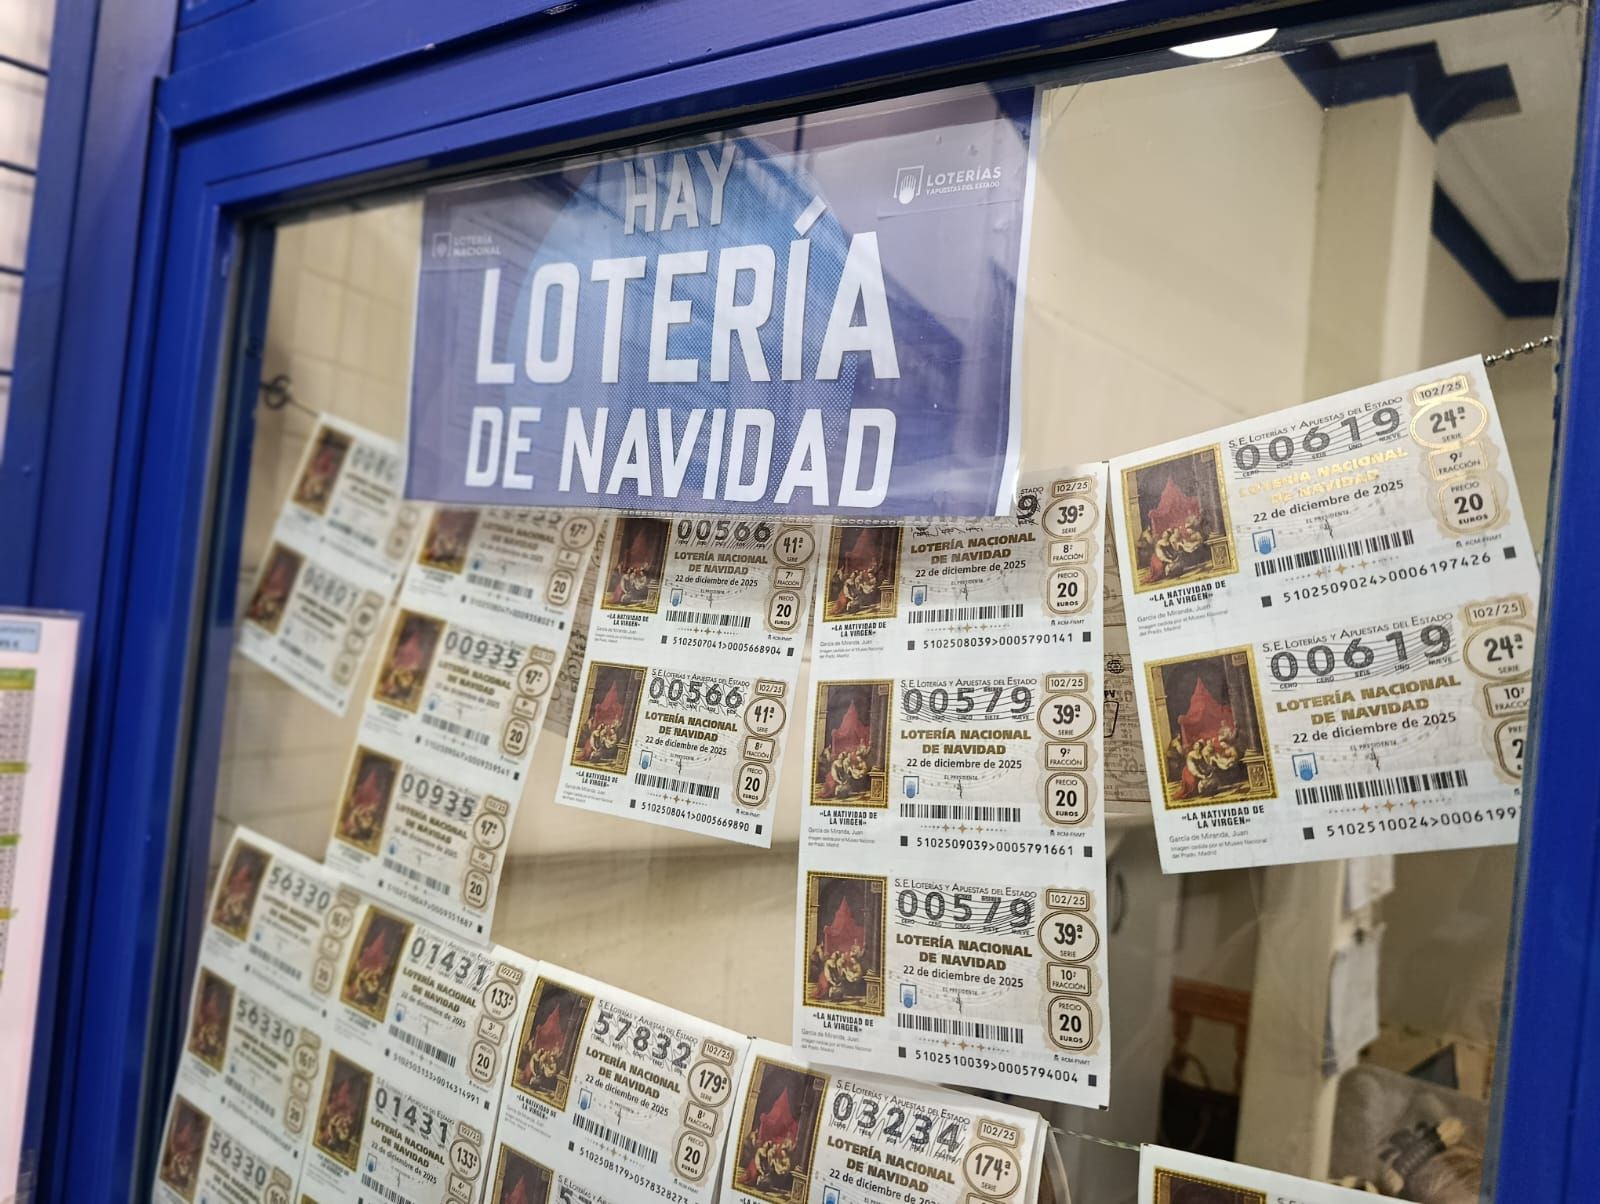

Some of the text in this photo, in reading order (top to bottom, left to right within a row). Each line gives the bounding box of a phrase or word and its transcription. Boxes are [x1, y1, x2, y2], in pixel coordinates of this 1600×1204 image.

[926, 164, 1001, 188] LOTERÍAS
[623, 142, 736, 235] HAY
[476, 195, 901, 384] LOTERÍA
[1419, 381, 1462, 399] 102/25
[1236, 407, 1402, 472] 00619
[465, 407, 897, 509] DE NAVIDAD
[1057, 481, 1087, 491] 102/25
[1253, 480, 1404, 523] 22 de diciembre de 2025
[1454, 492, 1485, 515] 20
[678, 518, 772, 542] 00566
[911, 538, 963, 553] LOTERÍA
[968, 532, 1036, 547] NACIONAL
[674, 550, 768, 563] LOTERÍA NACIONAL
[931, 548, 1011, 564] DE NAVIDAD
[703, 565, 749, 574] NAVIDAD
[929, 568, 939, 577] de
[942, 563, 986, 576] diciembre
[989, 563, 999, 571] de
[1004, 560, 1026, 570] 2025
[1283, 550, 1493, 603] 5102509024>0006197426
[1058, 582, 1078, 598] 20
[1167, 582, 1213, 599] NATIVIDAD
[1214, 580, 1226, 588] DE
[775, 604, 792, 617] 20
[1163, 600, 1174, 608] LA
[1474, 603, 1521, 620] 102/25
[923, 633, 1073, 649] 5102508039>0005790141
[1285, 633, 1328, 648] LOTERÍAS
[1339, 623, 1390, 639] APUESTAS
[1394, 621, 1410, 630] DEL
[1412, 611, 1455, 627] ESTADO
[446, 631, 520, 669] 00935
[1269, 624, 1456, 683] 00619
[650, 676, 744, 709] 00566
[917, 679, 946, 687] LOTERÍAS
[955, 678, 991, 686] APUESTAS
[1008, 677, 1037, 685] ESTADO
[1051, 678, 1083, 687] 102/25
[1275, 675, 1462, 712] LOTERÍA NACIONAL
[903, 687, 1032, 714] 00579
[1310, 698, 1430, 725] DE NAVIDAD
[645, 709, 738, 732] LOTERÍA NACIONAL
[1292, 712, 1457, 744] 22 de diciembre de 2025
[658, 726, 718, 742] DE NAVIDAD
[901, 728, 1031, 739] LOTERÍA NACIONAL
[655, 737, 663, 745] de
[665, 739, 698, 751] diciembre
[700, 744, 708, 752] de
[710, 746, 727, 755] 2025
[923, 745, 1006, 754] DE NAVIDAD
[920, 759, 931, 767] de
[935, 759, 980, 768] diciembre
[984, 760, 994, 768] de
[999, 760, 1022, 768] 2025
[401, 773, 474, 817] 00935
[744, 776, 761, 792] 20
[1056, 790, 1077, 806] 20
[641, 802, 750, 831] 5102508041>0005669890
[917, 837, 1072, 856] 5102509039>0005791661
[897, 889, 1032, 928] 00579
[1052, 894, 1085, 906] 102/25
[896, 931, 1032, 957] LOTERÍA NACIONAL
[412, 937, 488, 986] 01431
[919, 952, 1006, 970] DE NAVIDAD
[903, 966, 1023, 987] 22 de diciembre de 2025
[1059, 1014, 1080, 1033] 20
[594, 1010, 690, 1069] 57832
[586, 1044, 682, 1093] LOTERÍA NACIONAL
[916, 1050, 1077, 1085] 5102510039>0005794004
[599, 1066, 660, 1099] DE NAVIDAD
[376, 1088, 449, 1144] 01431
[833, 1091, 960, 1152] 03234
[372, 1115, 445, 1165] LOTERÍA NACIONAL
[983, 1124, 1016, 1143] 102/25
[382, 1135, 429, 1169] DE NAVIDAD
[684, 1146, 701, 1166] 20
[828, 1132, 956, 1184] LOTERÍA NACIONAL
[847, 1158, 929, 1193] DE NAVIDAD
